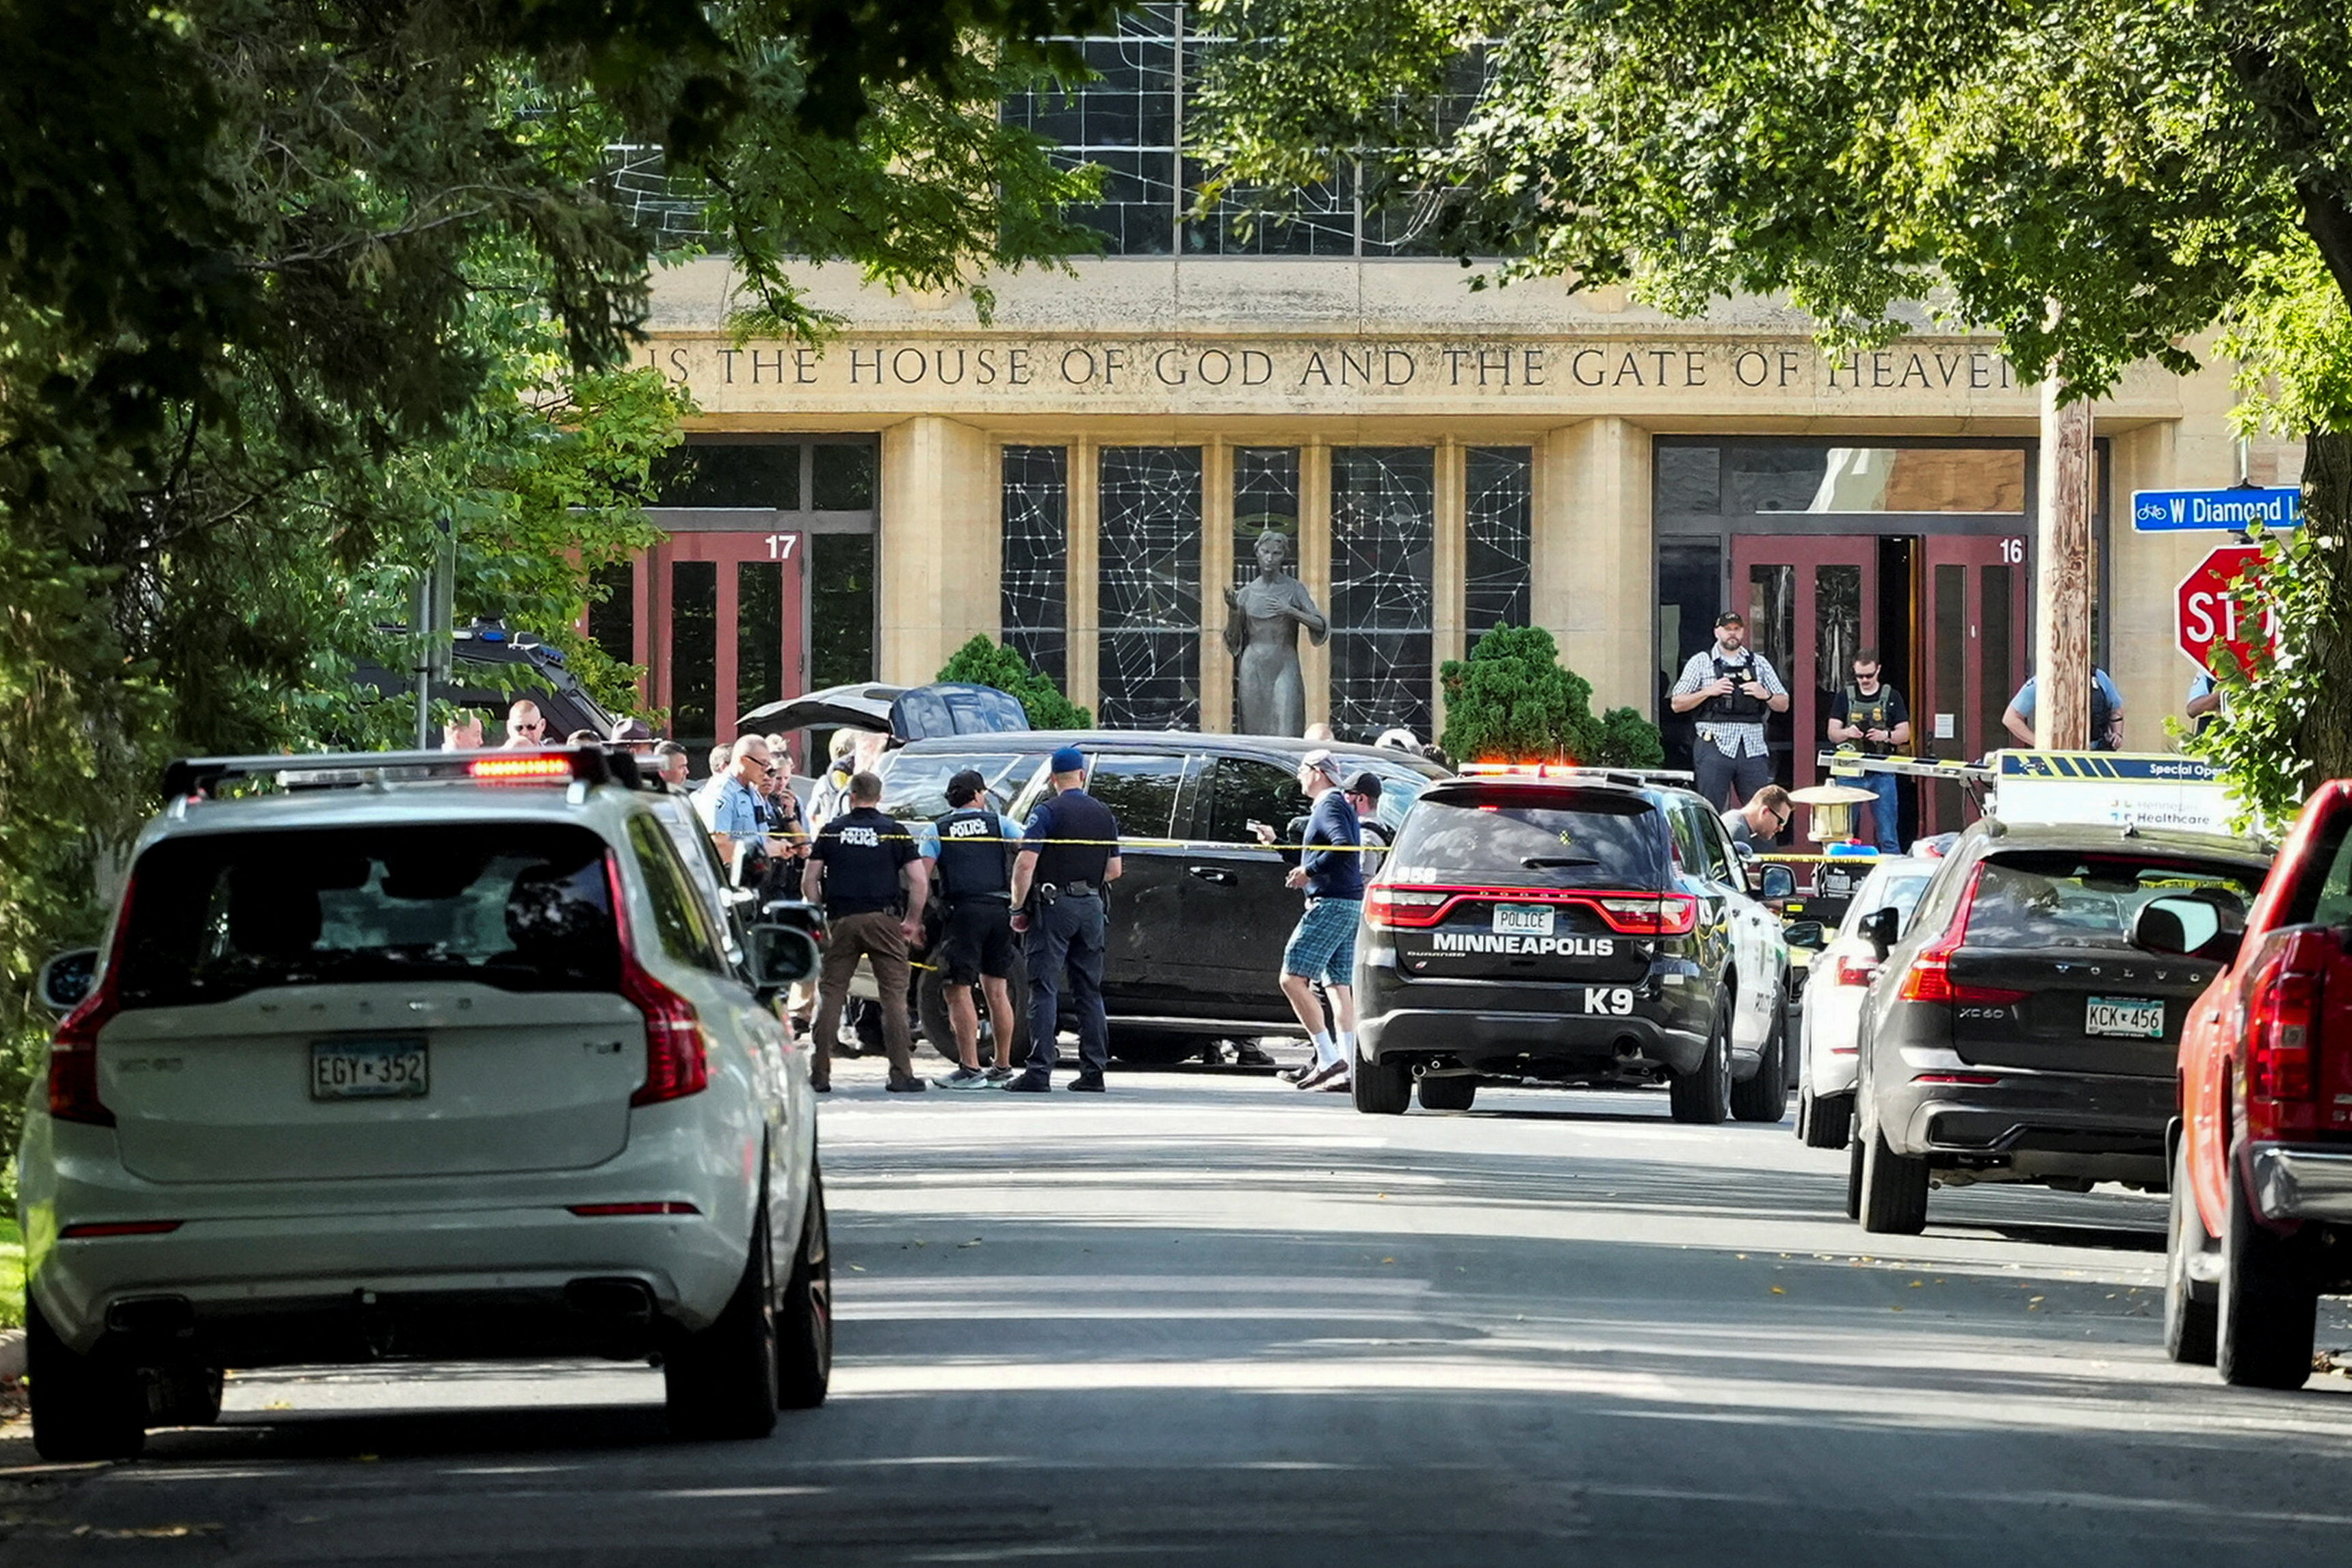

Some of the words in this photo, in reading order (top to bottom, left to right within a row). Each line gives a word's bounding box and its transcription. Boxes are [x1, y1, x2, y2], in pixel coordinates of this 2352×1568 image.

[717, 349, 818, 384] THE
[849, 348, 1031, 384] HOUSE
[1061, 348, 1125, 384] OF
[1155, 348, 1272, 386] GOD
[1300, 350, 1415, 386] AND
[1442, 350, 1546, 386] THE
[1572, 349, 1707, 387] GATE
[1736, 350, 1799, 387] OF
[2170, 499, 2186, 523] W
[2193, 497, 2282, 523] Diamond
[766, 535, 796, 559] 17
[2000, 538, 2023, 563] 16
[2150, 763, 2193, 776] Special
[950, 819, 988, 838] POLICE
[2137, 812, 2210, 824] Healthcare
[840, 831, 878, 847] POLICE
[1500, 911, 1545, 928] POLICE
[1433, 932, 1614, 956] MINNEAPOLIS
[1584, 988, 1634, 1015] K9
[1959, 1007, 2004, 1019] XC60
[2089, 1006, 2119, 1027] KCK
[2130, 1008, 2159, 1030] 456
[317, 1057, 360, 1086] EGY
[377, 1054, 422, 1084] 352
